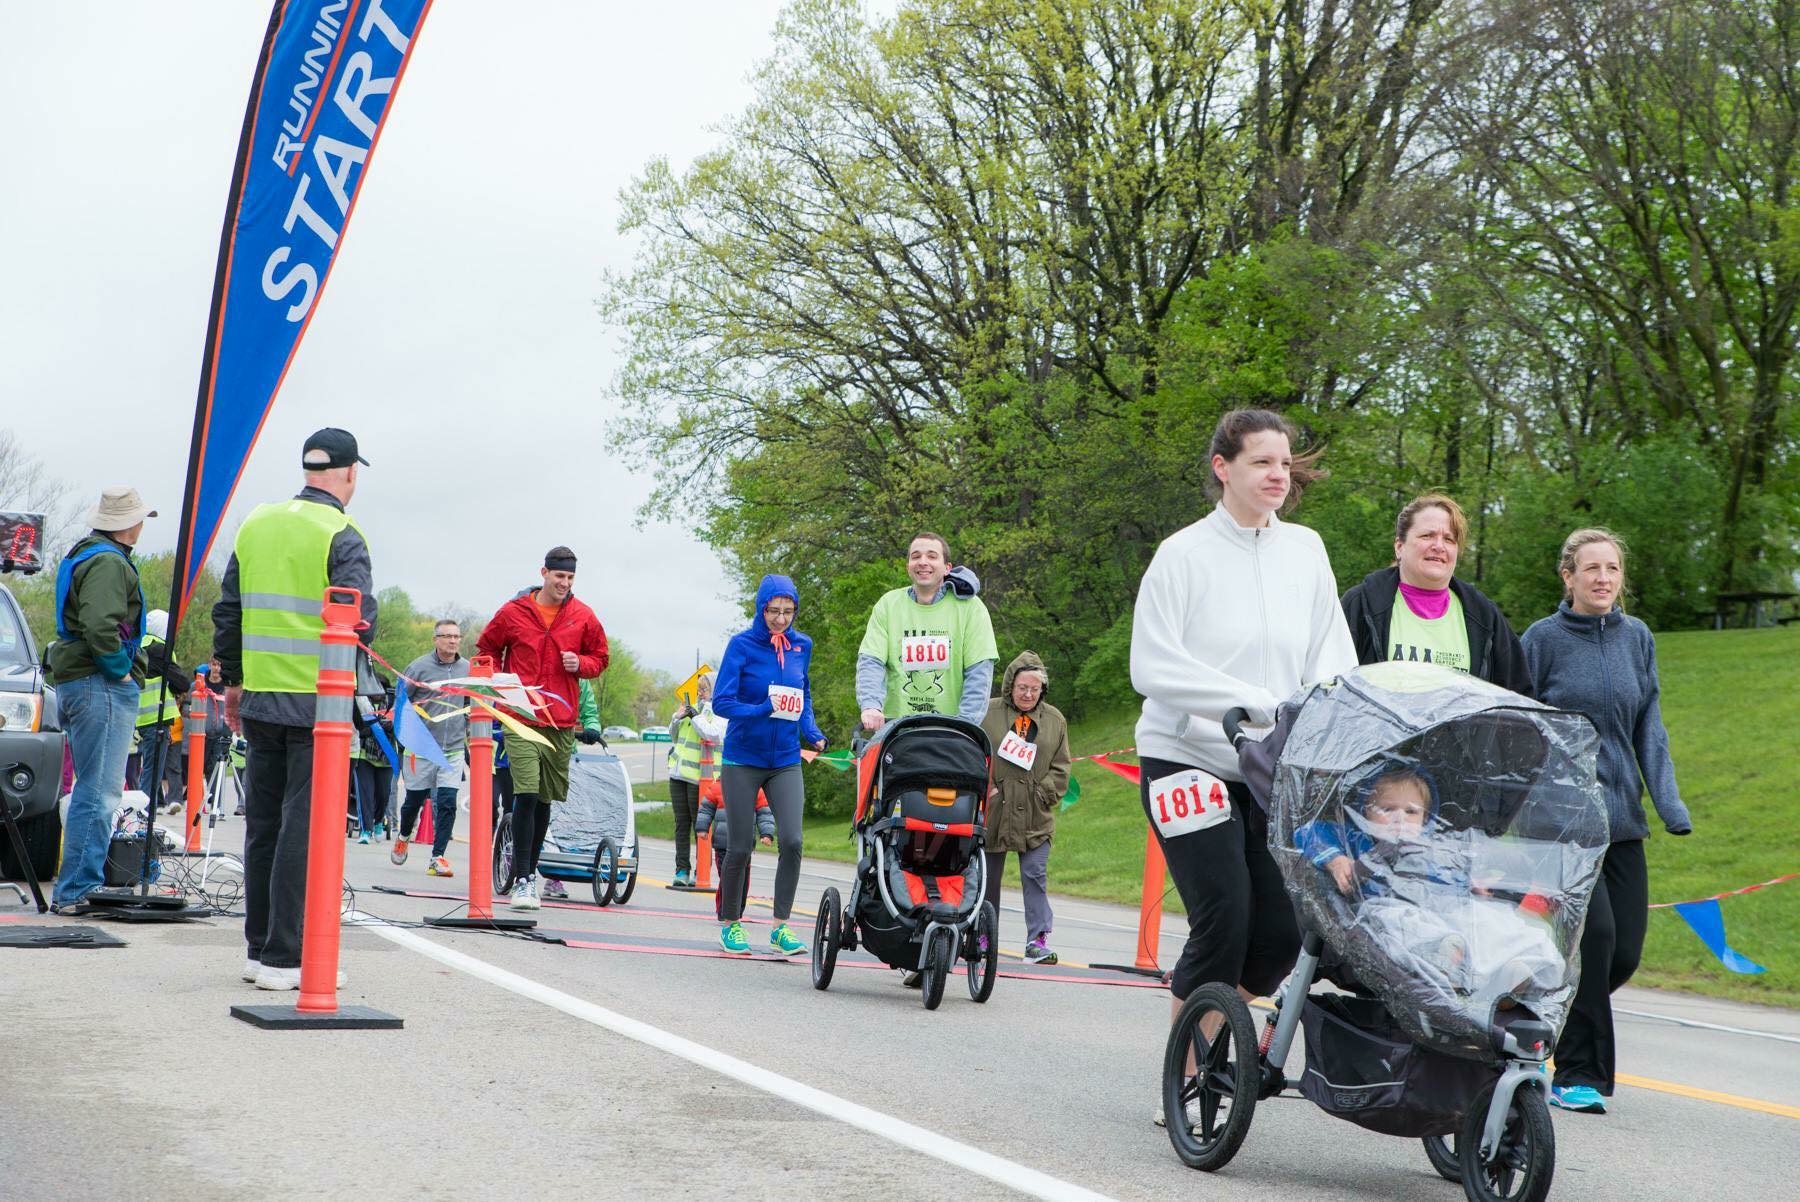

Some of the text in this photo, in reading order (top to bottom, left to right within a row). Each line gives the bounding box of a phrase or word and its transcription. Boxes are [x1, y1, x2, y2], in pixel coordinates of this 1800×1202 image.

[262, 0, 410, 323] START
[906, 644, 946, 662] 1810
[779, 694, 801, 713] 809
[1156, 783, 1225, 823] 1814
